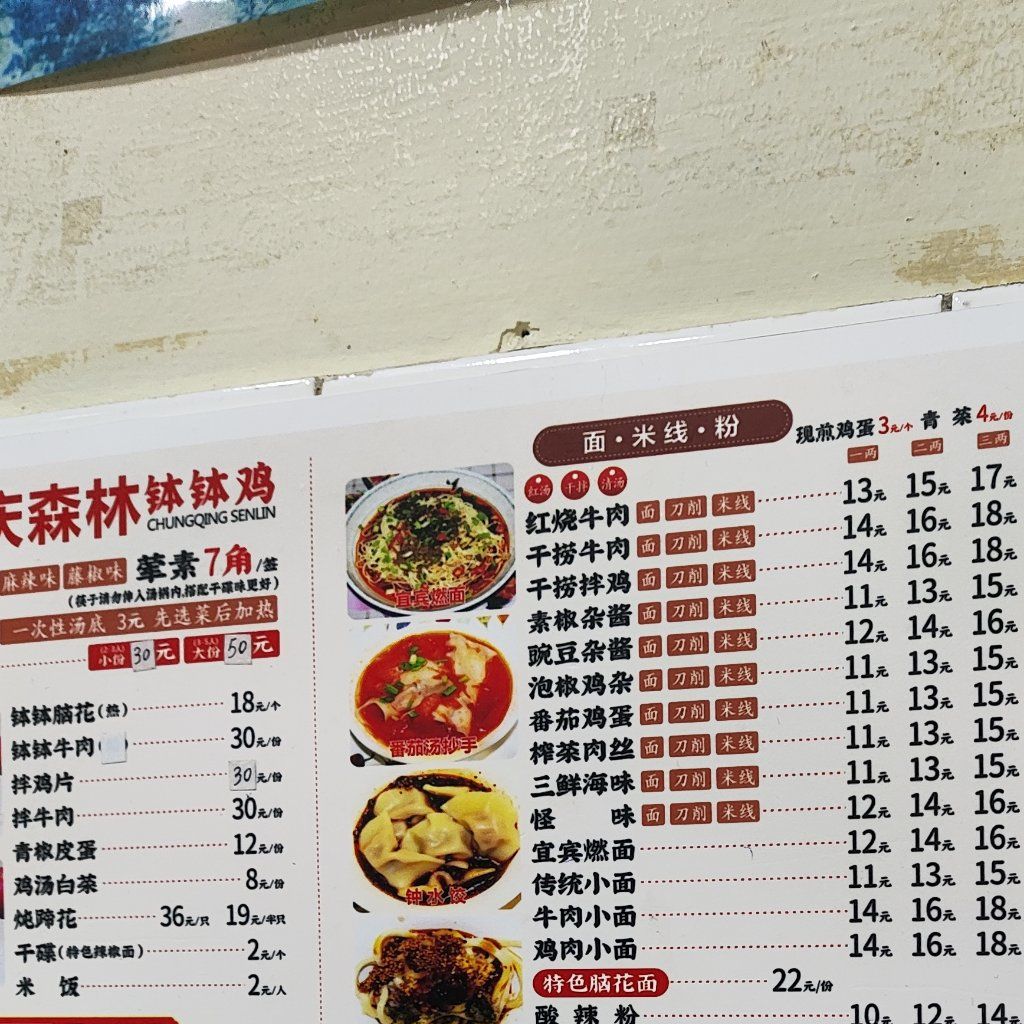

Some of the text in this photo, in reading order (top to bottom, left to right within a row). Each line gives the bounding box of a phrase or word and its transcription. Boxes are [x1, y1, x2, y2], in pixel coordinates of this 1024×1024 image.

[144, 461, 275, 513] 钵钵鸡
[525, 463, 1017, 535] 红烧牛肉 刀削 米线 13元 15元 17元
[147, 506, 276, 532] CHUNGQING SENLIN
[526, 535, 631, 568] 干捞牛肉
[1, 569, 58, 592] 麻辣味
[66, 561, 125, 585] 藤椒味
[526, 569, 632, 602] 干捞拌鸡
[12, 599, 275, 640] 一次性汤底 3元 先选菜后加热
[527, 602, 633, 634] 素椒杂酱
[133, 646, 150, 665] 30
[155, 642, 176, 661] 元
[227, 637, 248, 659] 50
[252, 635, 275, 654] 元
[528, 636, 633, 667] 豌豆杂酱
[529, 670, 634, 700] 泡椒鸡杂
[230, 691, 281, 713] 18元/个
[529, 703, 635, 732] 番茄鸡蛋
[230, 726, 282, 749] 30元/份
[529, 737, 635, 765] 榨菜肉丝
[11, 772, 74, 795] 拌鸡片
[233, 766, 252, 786] 30
[530, 769, 636, 799] 三鲜海味
[12, 805, 74, 829] 拌牛肉
[12, 840, 97, 862] 青椒皮蛋
[531, 837, 636, 865] 宜宾燃面
[13, 868, 285, 896] 鸡汤白菜 8元/份
[531, 870, 637, 897] 传统小面
[13, 903, 286, 930] 炖蹄花 36元/只 19元/半只
[532, 904, 637, 930] 牛肉小面
[247, 938, 286, 961] 2元/个
[533, 936, 638, 963] 鸡肉小面
[247, 974, 287, 996] 2元/人
[542, 968, 834, 994] 特色脑花面 22元/份
